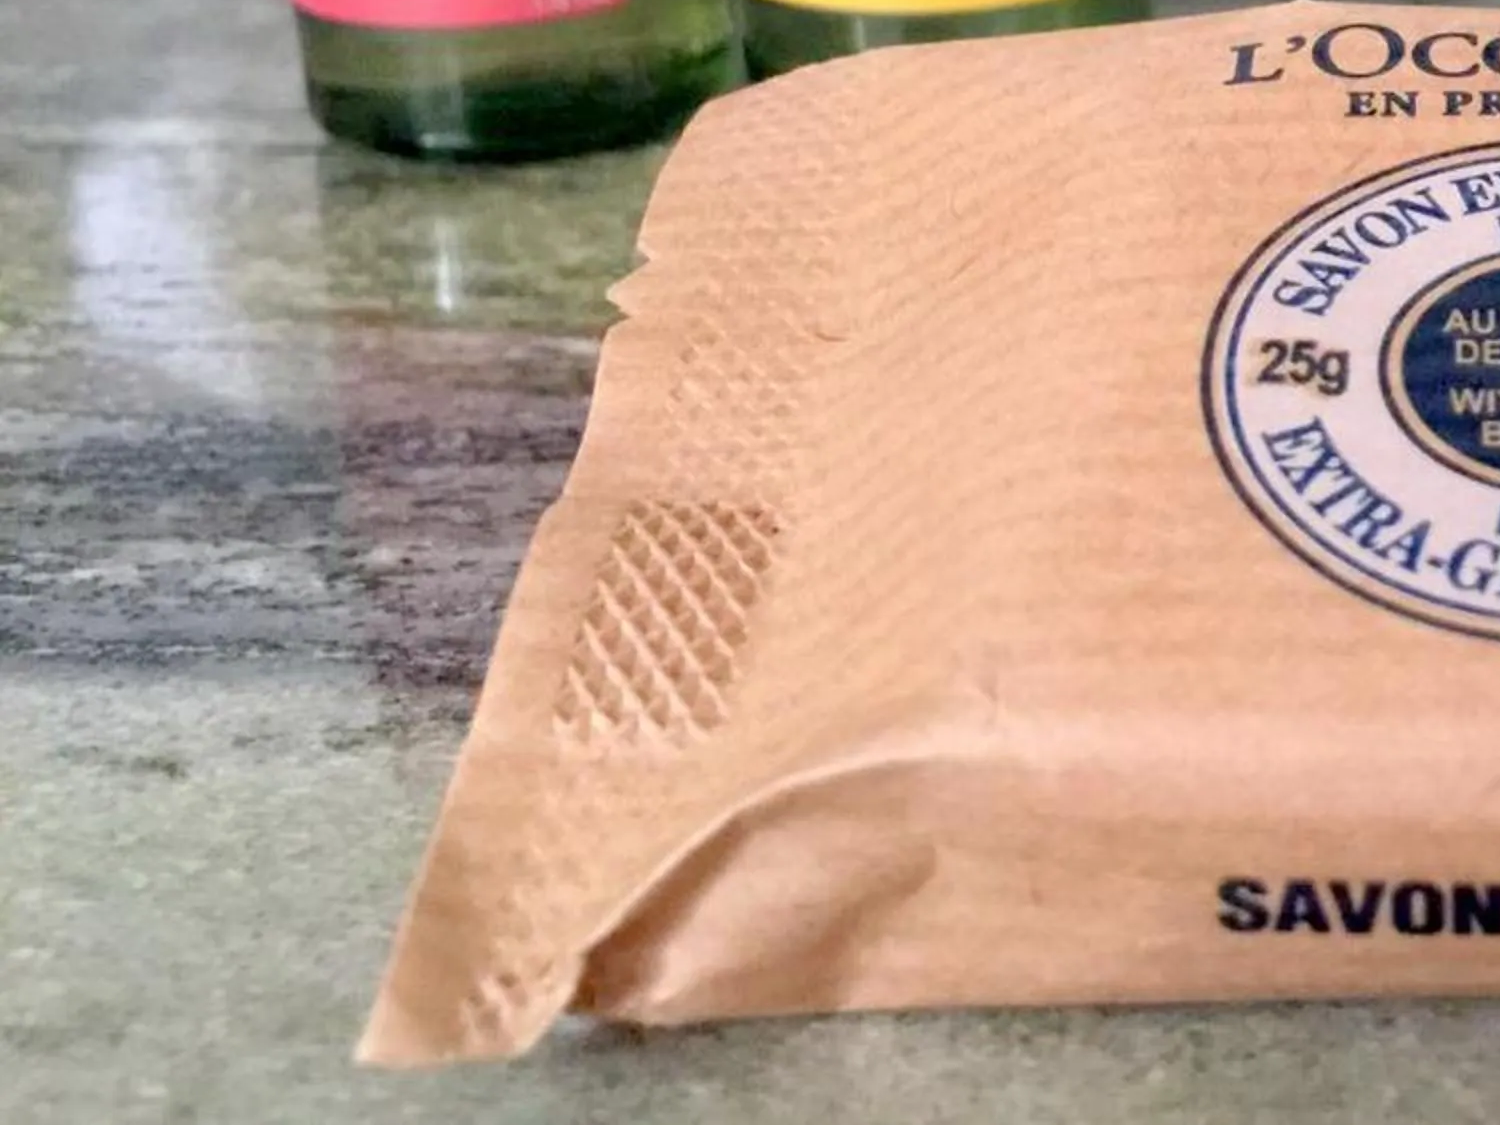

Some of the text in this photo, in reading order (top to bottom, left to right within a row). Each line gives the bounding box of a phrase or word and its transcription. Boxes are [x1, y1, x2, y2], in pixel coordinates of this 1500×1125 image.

[1344, 89, 1419, 117] EN
[1272, 187, 1451, 316] SAVON
[1443, 308, 1496, 334] AU
[1258, 340, 1351, 396] 25g
